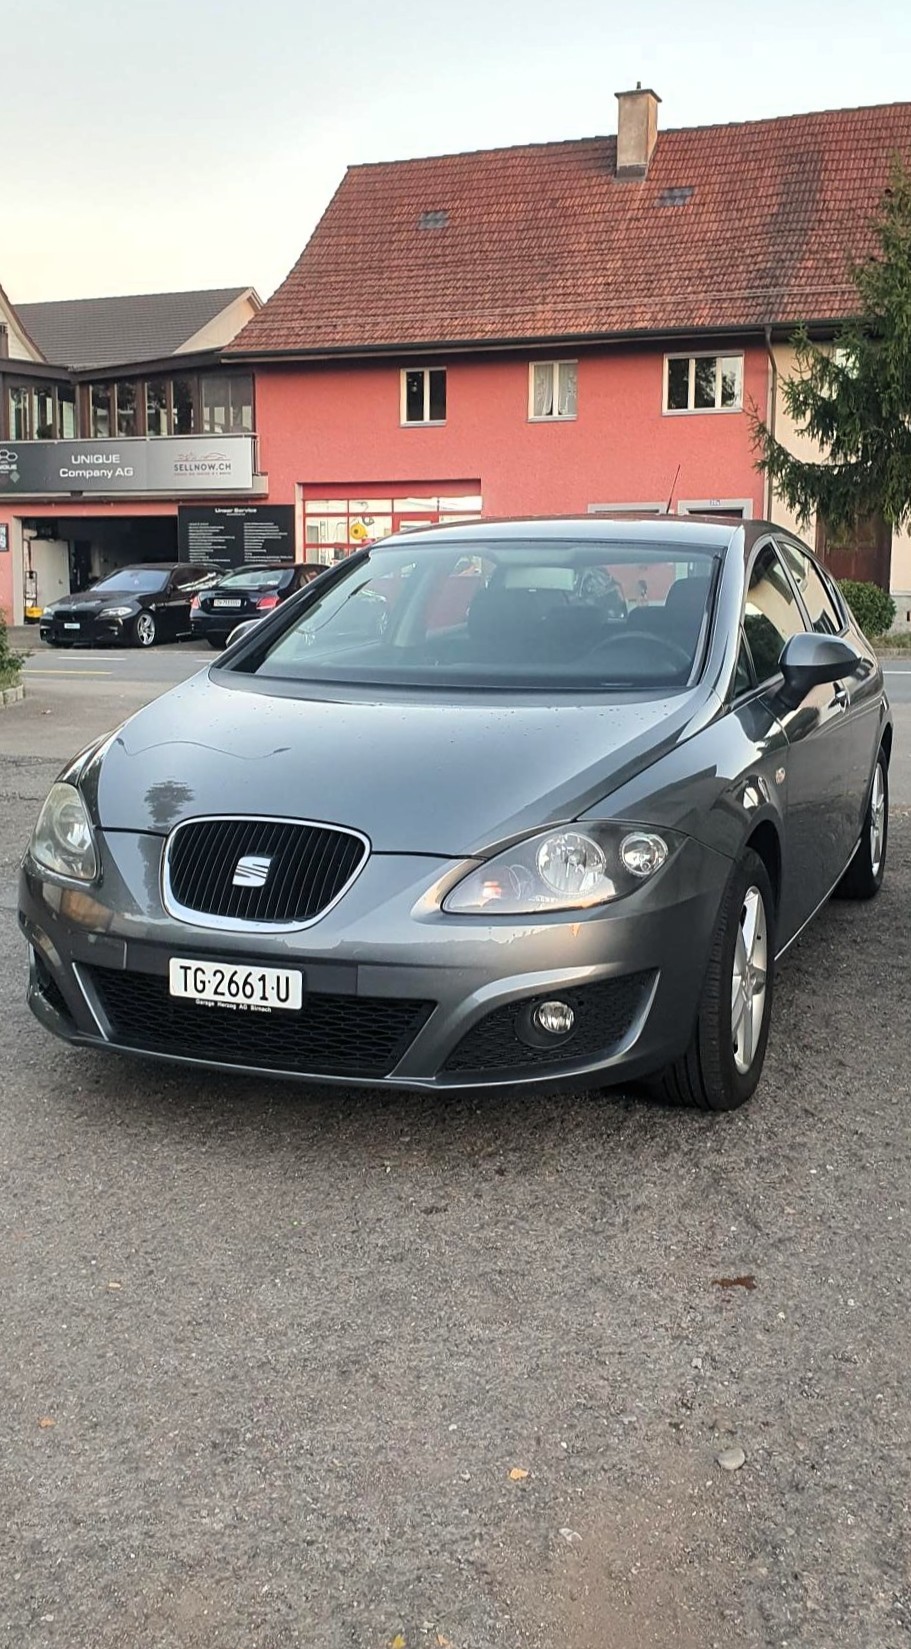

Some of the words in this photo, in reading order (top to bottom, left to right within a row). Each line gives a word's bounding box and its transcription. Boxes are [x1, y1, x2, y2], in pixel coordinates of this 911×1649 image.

[71, 454, 121, 464] UNIQUE
[174, 463, 232, 471] SELLNOW.CH
[59, 468, 113, 480] Company
[115, 467, 134, 477] AG
[195, 999, 215, 1007] Garage
